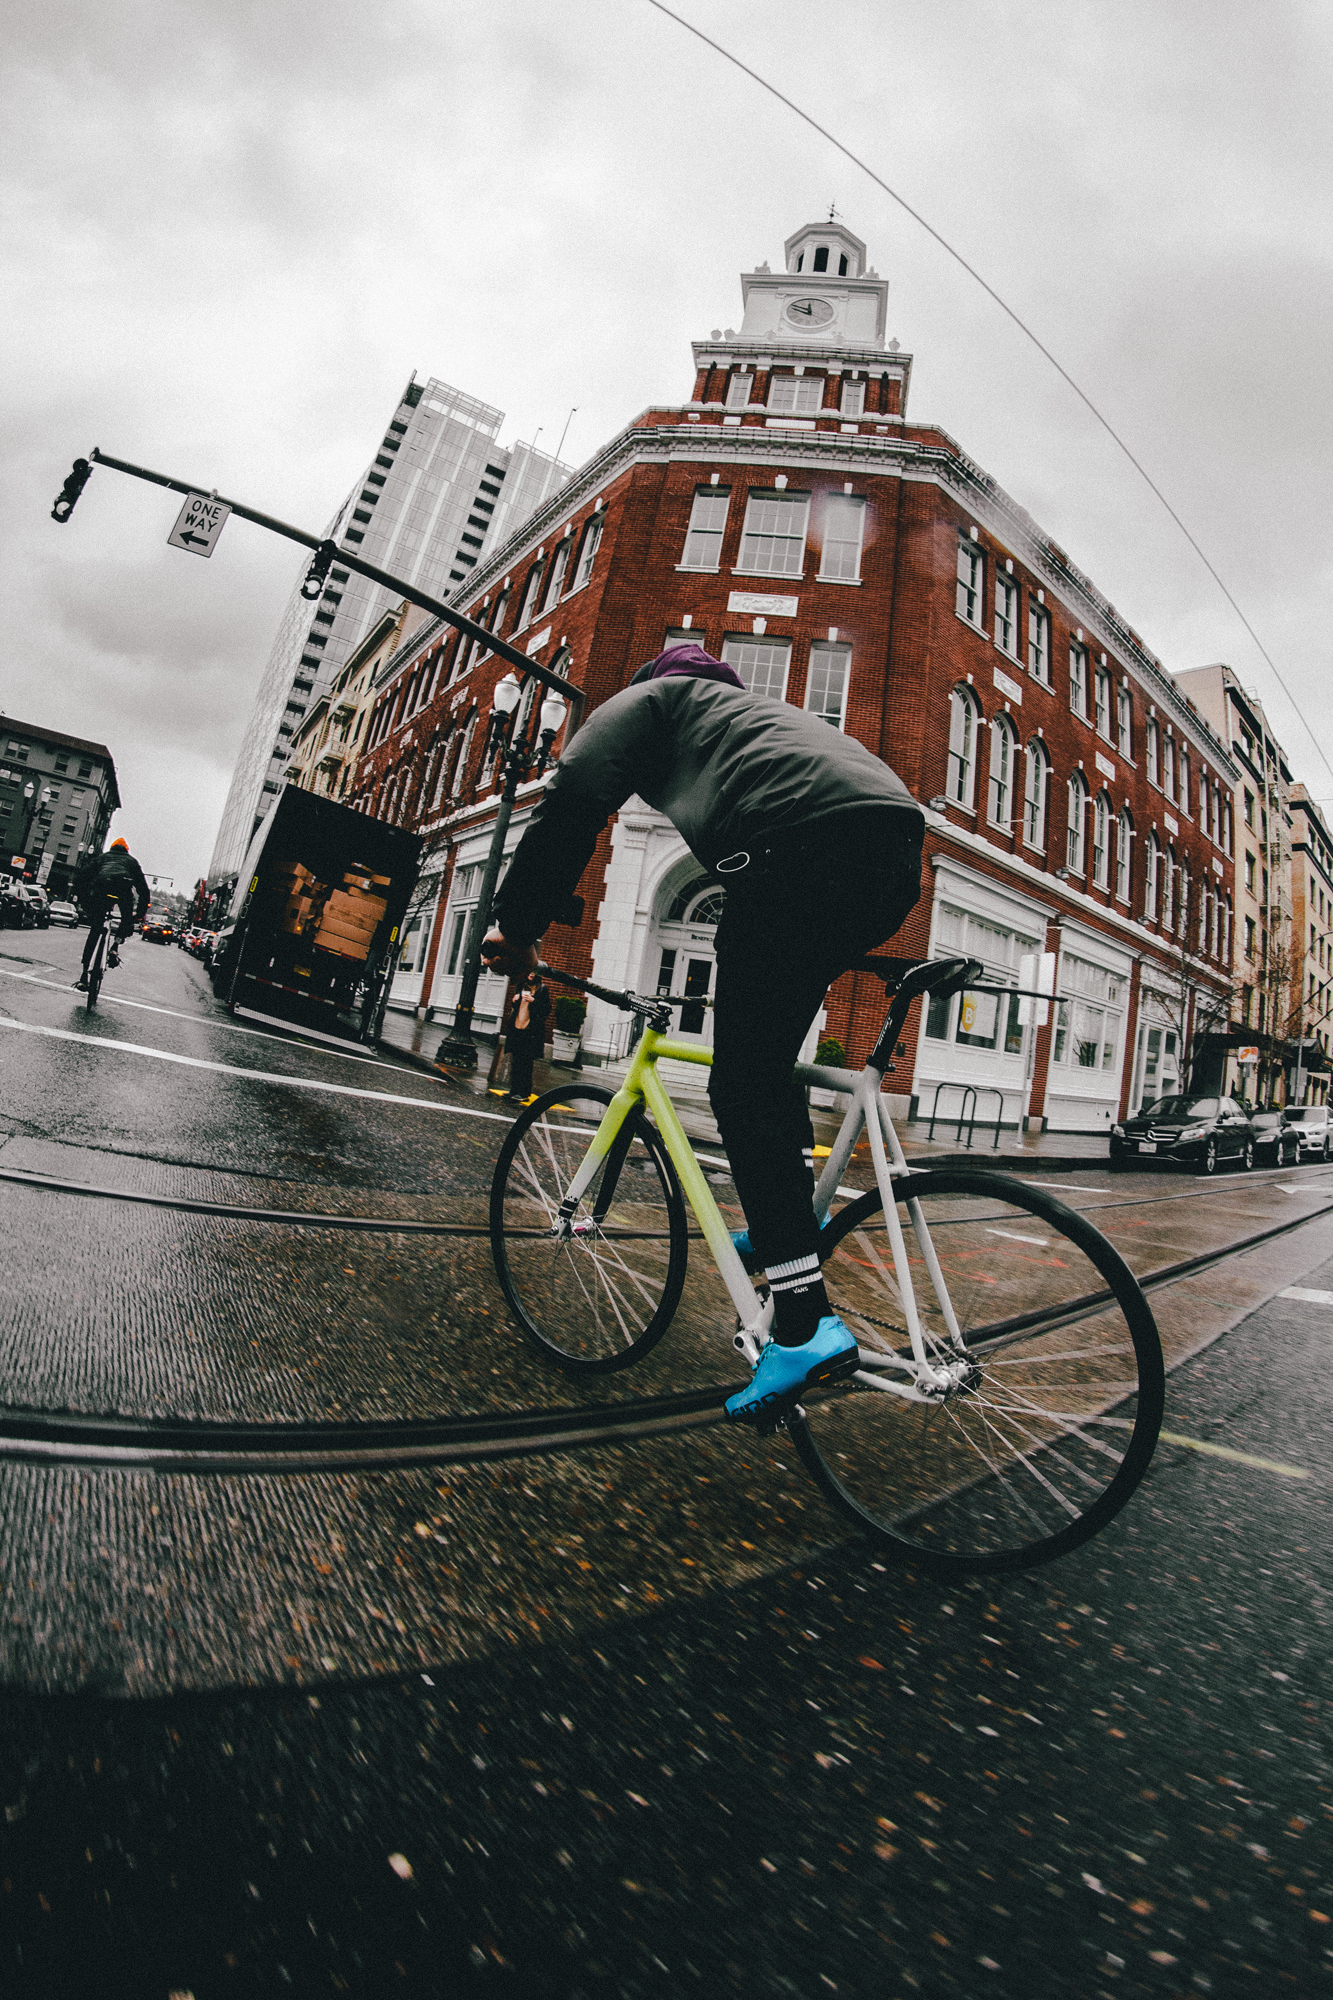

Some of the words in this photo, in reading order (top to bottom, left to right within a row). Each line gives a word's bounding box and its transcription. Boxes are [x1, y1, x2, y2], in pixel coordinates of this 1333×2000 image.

[192, 500, 222, 520] ONE
[185, 512, 218, 533] WAY
[965, 1006, 973, 1024] B
[793, 1286, 809, 1294] VANS
